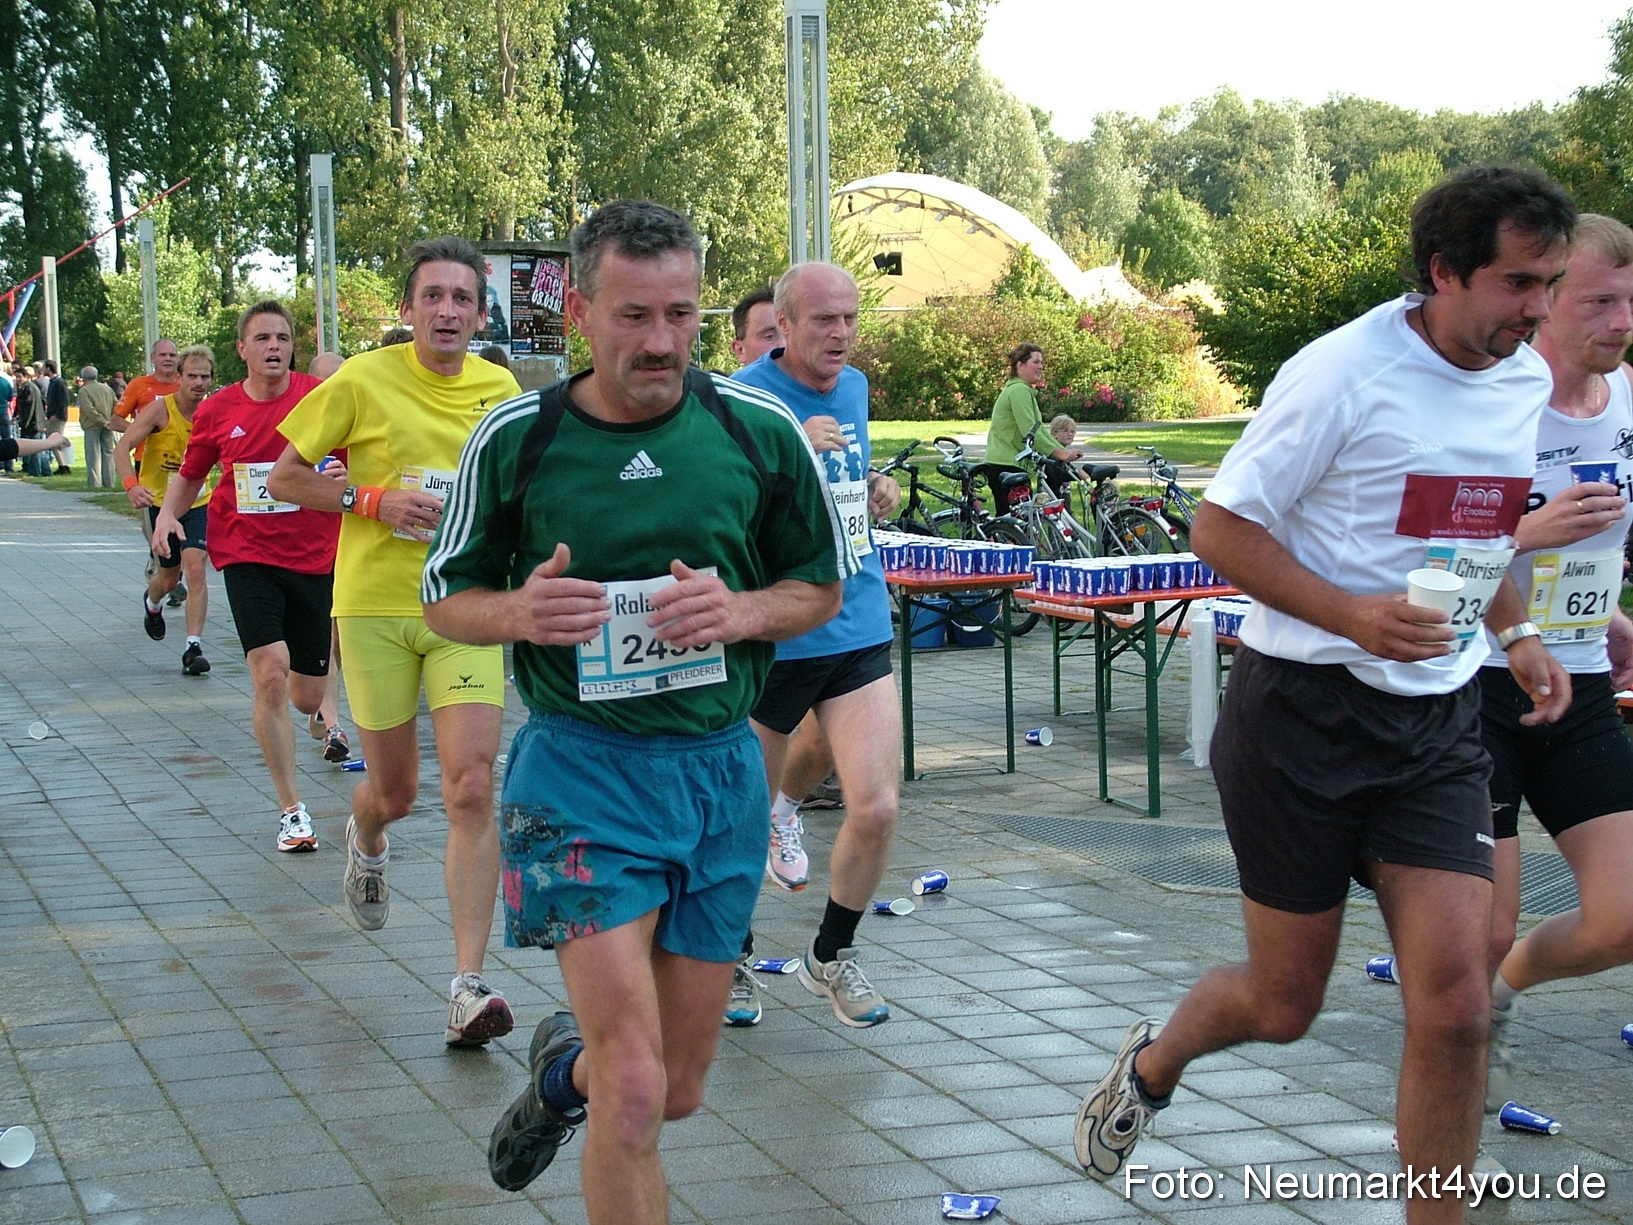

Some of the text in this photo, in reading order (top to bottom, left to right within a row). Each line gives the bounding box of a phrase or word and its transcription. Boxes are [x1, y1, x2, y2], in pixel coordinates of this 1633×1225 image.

[535, 272, 564, 300] ROCK
[620, 467, 663, 480] adidas
[833, 489, 866, 504] einhard
[844, 514, 865, 536] 88
[1562, 561, 1596, 578] Alwin
[1567, 588, 1609, 617] 621
[670, 664, 723, 681] PFLEIDERER
[581, 679, 637, 695] BOCK
